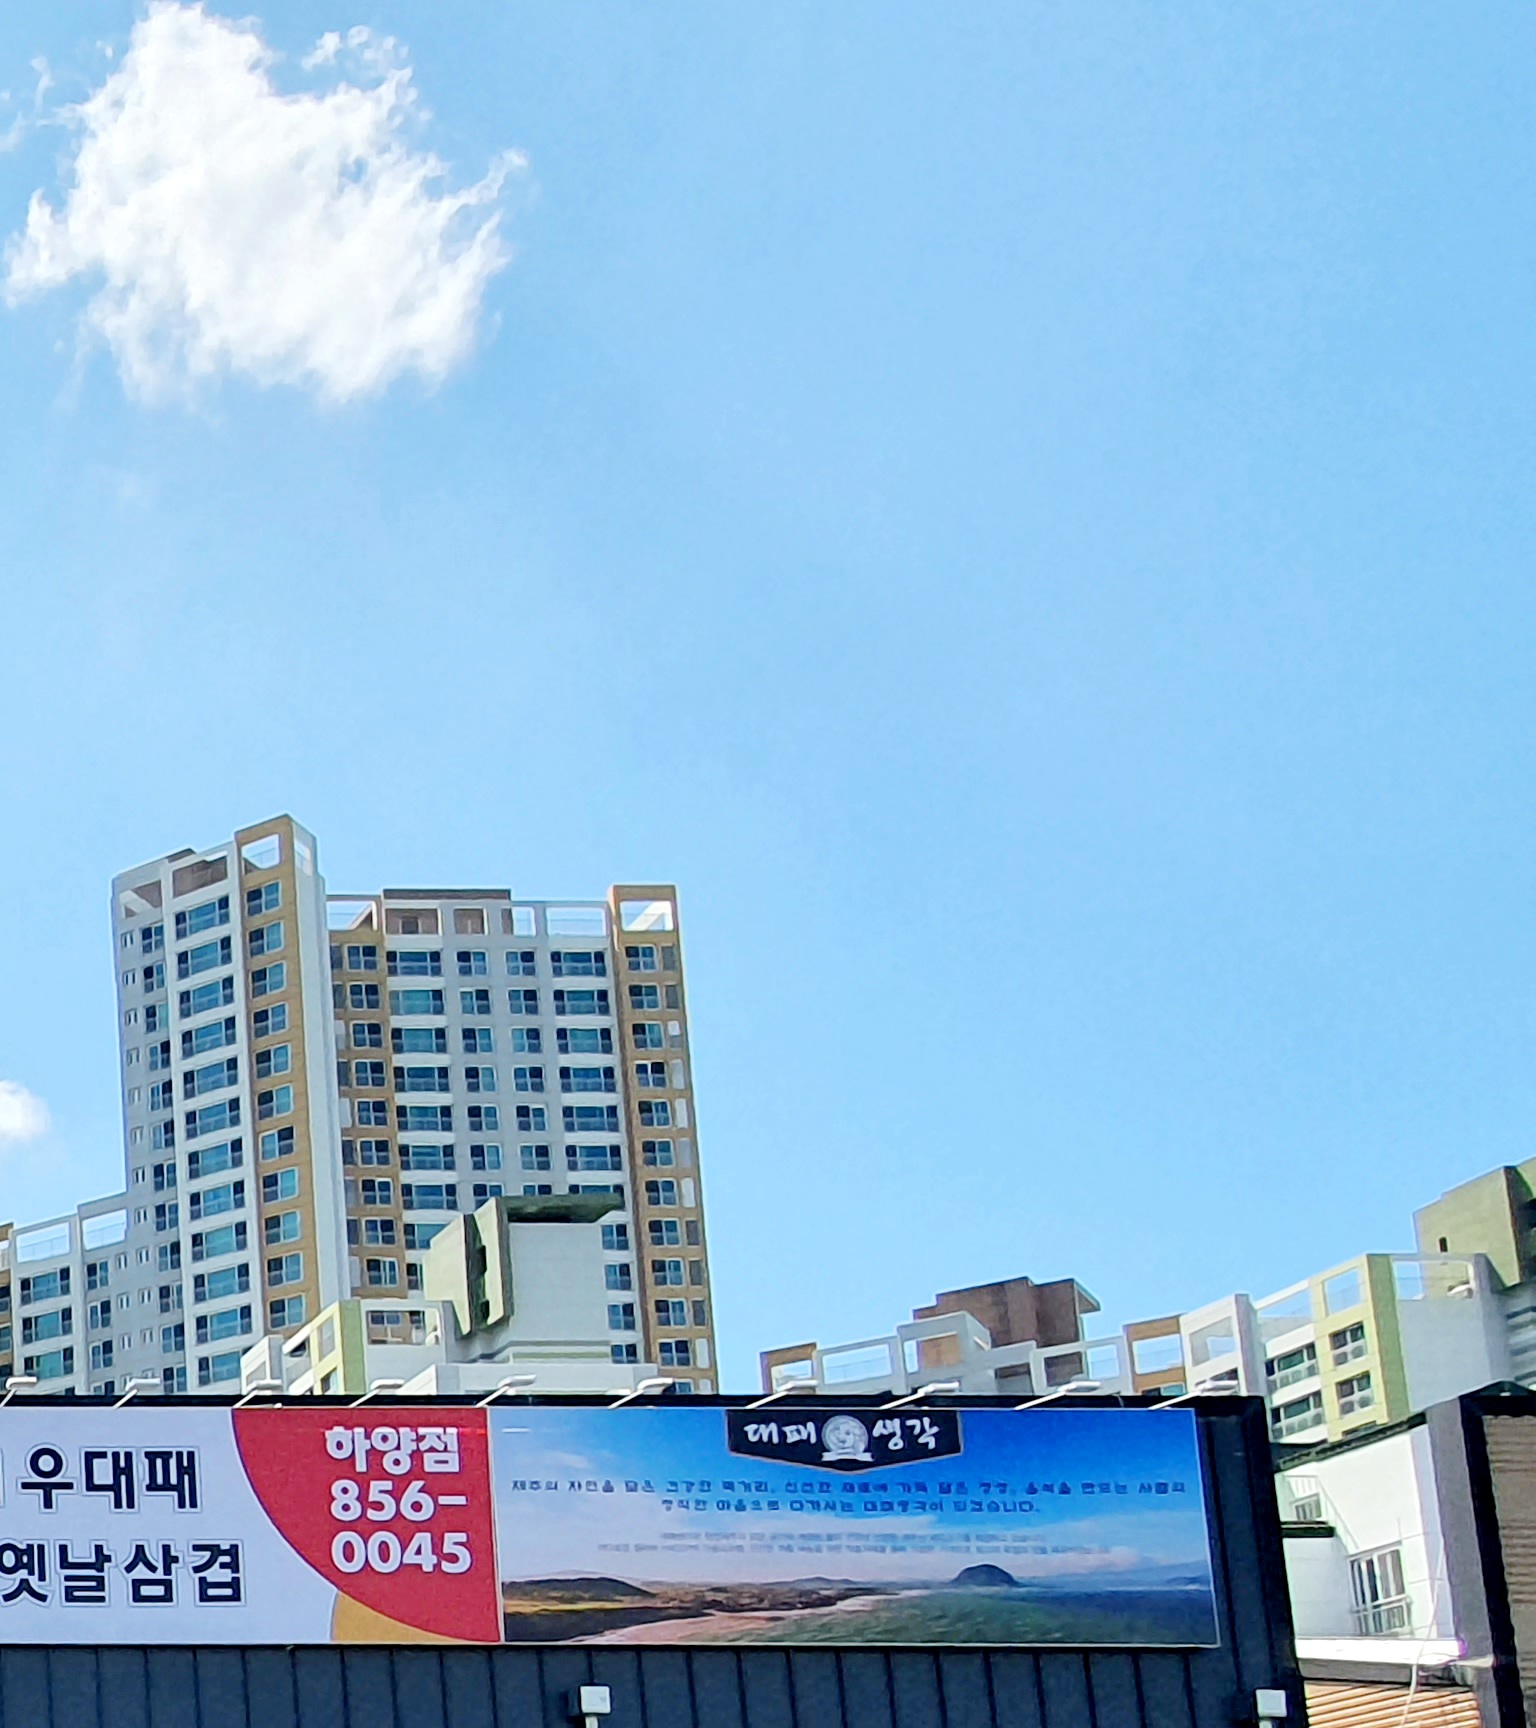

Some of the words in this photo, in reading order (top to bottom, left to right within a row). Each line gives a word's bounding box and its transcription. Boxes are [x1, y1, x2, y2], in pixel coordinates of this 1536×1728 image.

[325, 1425, 461, 1475] 하양점
[743, 1420, 818, 1445] 대패
[872, 1416, 940, 1451] 생각
[330, 1479, 469, 1524] 856-
[330, 1530, 472, 1575] 0045
